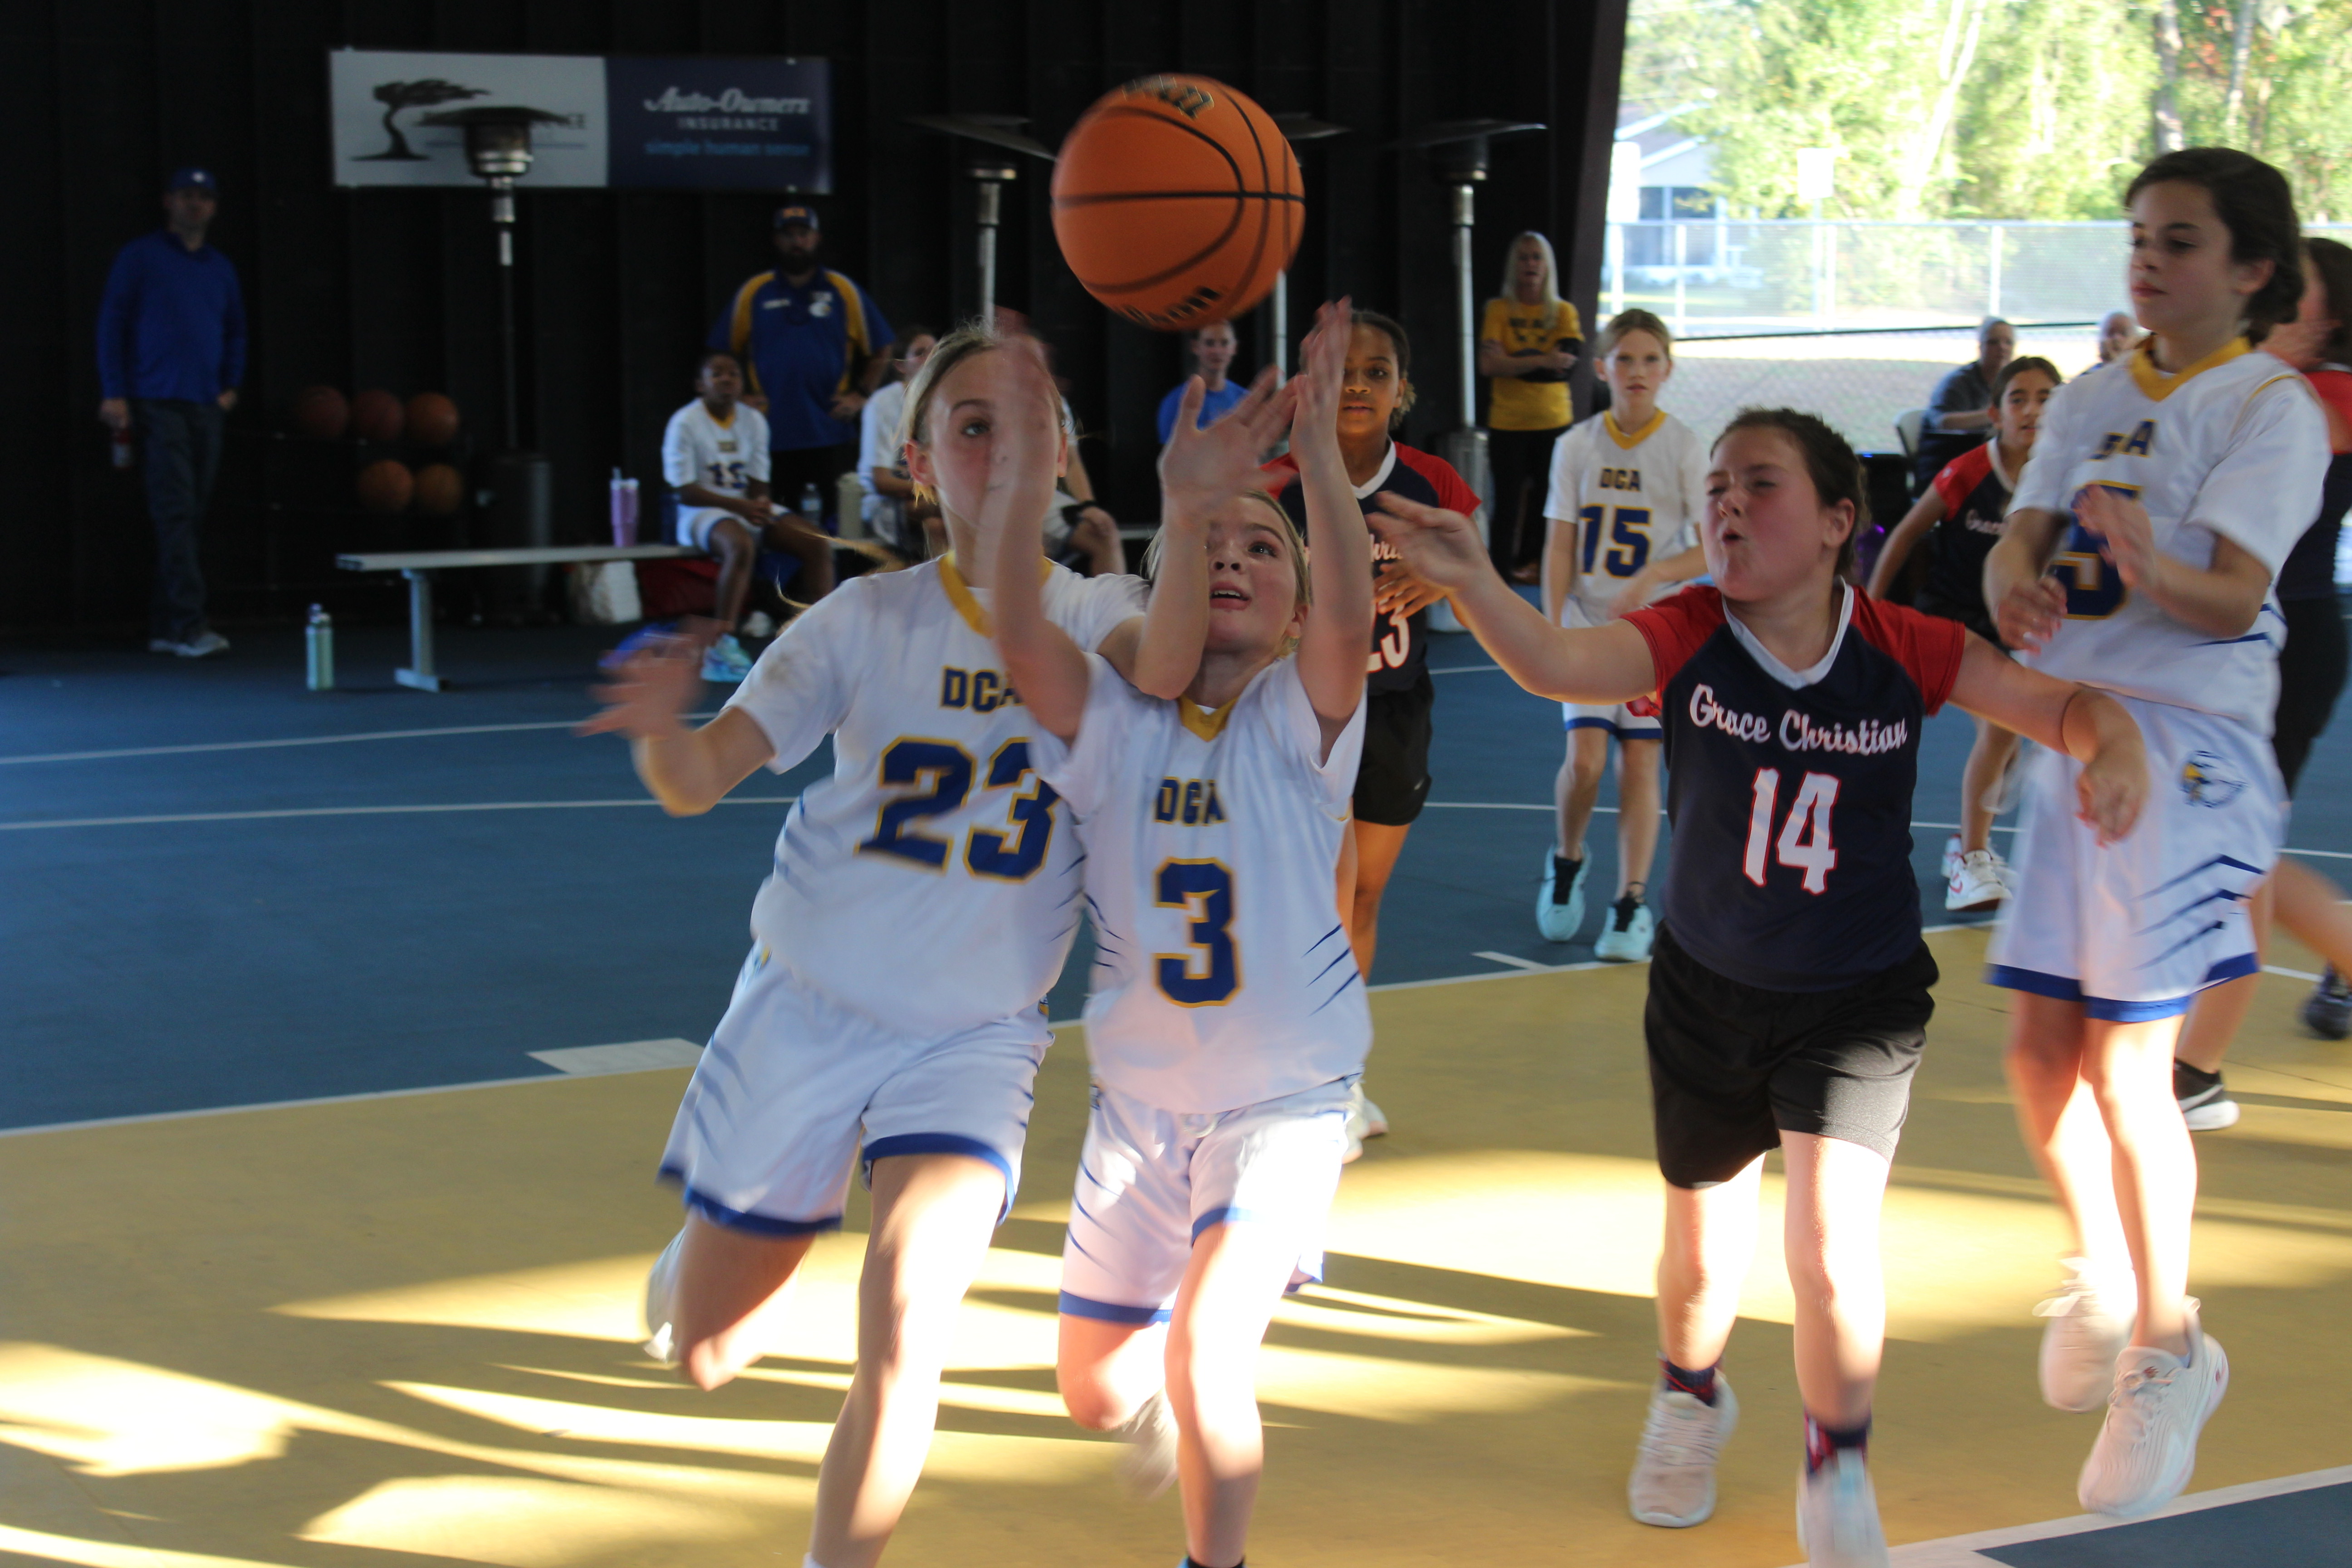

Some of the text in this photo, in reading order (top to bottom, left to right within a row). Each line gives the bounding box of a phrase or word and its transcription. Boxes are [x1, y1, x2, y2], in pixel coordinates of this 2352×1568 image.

[643, 86, 810, 115] Auto-Owners
[677, 117, 779, 131] INSURANCE
[1599, 467, 1642, 492] DCA
[1579, 503, 1653, 579] 15
[938, 664, 1028, 715] DCA
[1689, 683, 1908, 756] Grace Christian
[853, 734, 1063, 886] 23
[1153, 776, 1230, 827] DCA
[1742, 767, 1841, 896] 14
[1152, 856, 1245, 1009] 3
